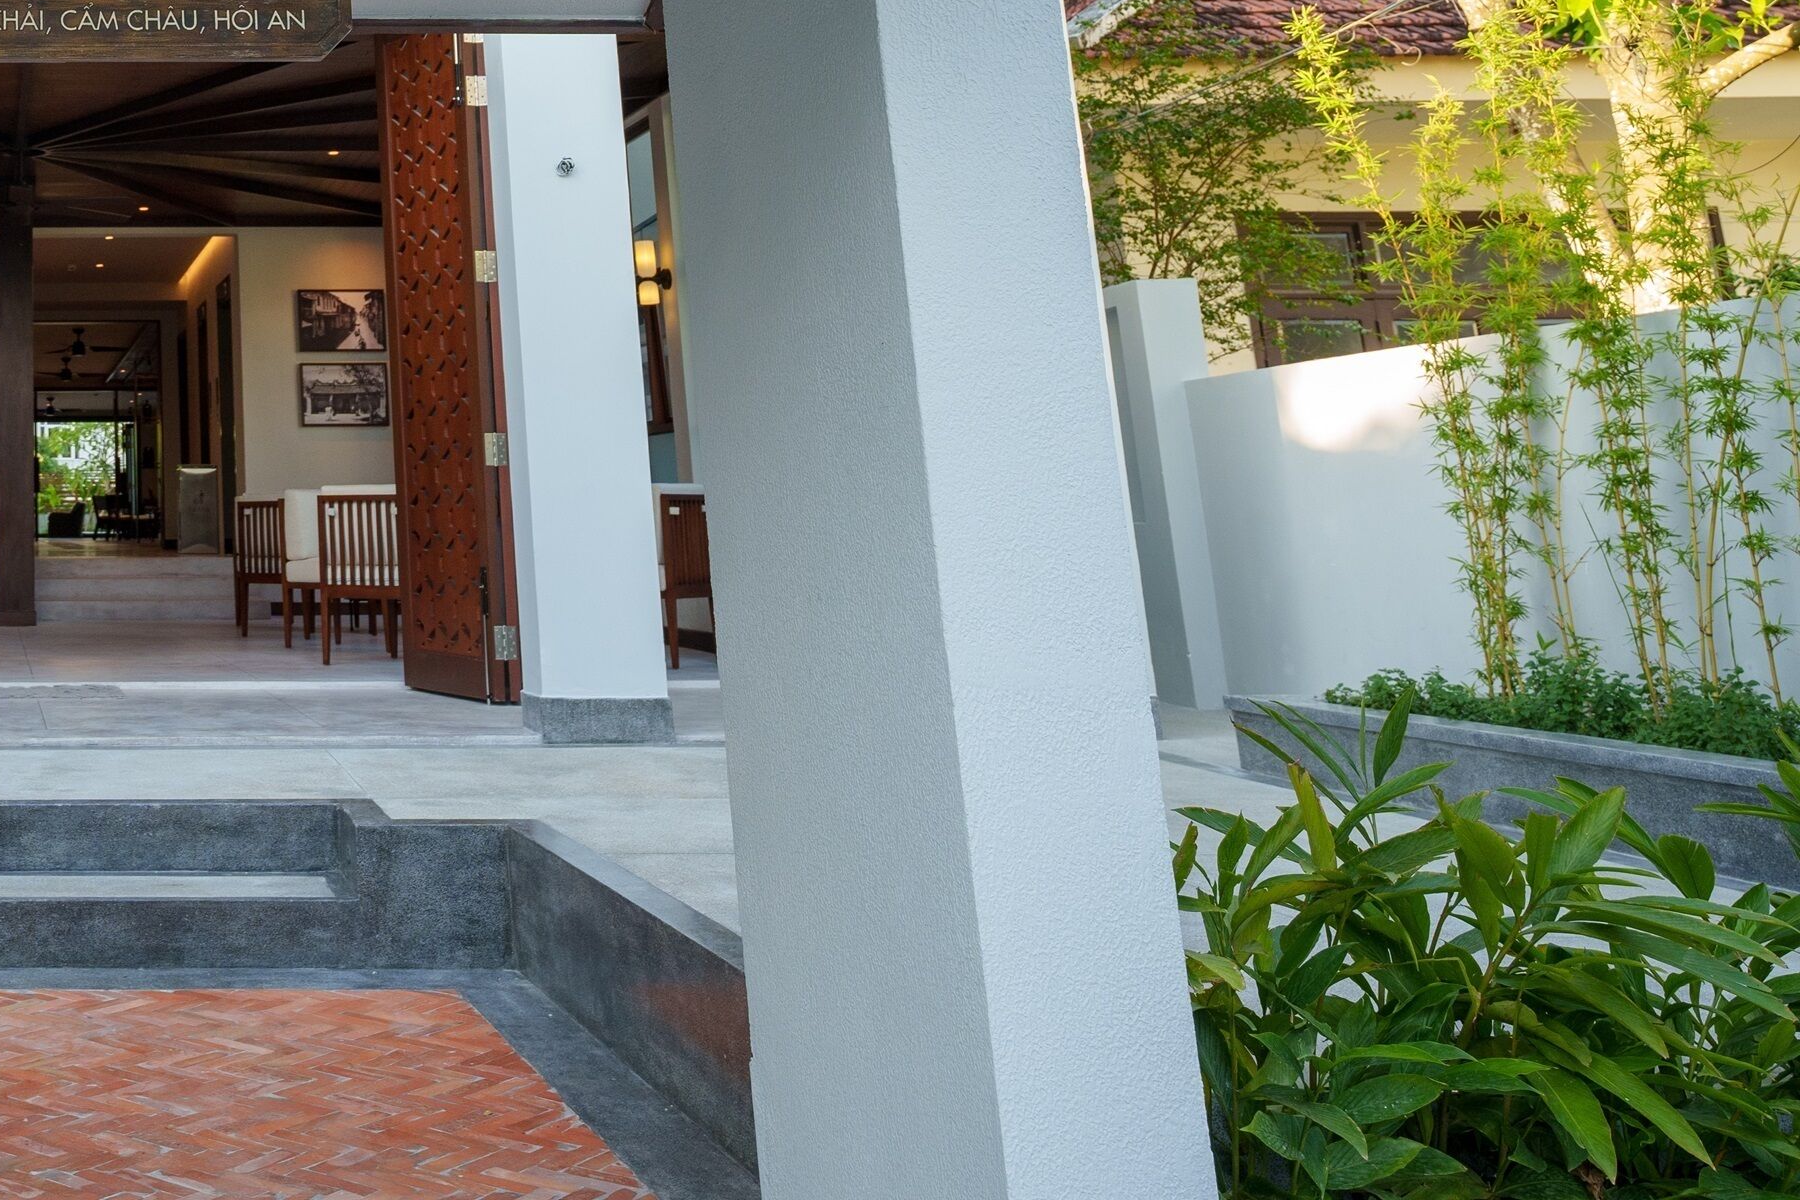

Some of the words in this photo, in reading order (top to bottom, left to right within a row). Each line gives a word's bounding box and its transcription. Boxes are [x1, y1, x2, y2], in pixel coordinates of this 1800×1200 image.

[60, 2, 119, 31] CẨM
[126, 5, 206, 35] CHÂU,
[214, 4, 259, 35] HỘI
[266, 9, 306, 31] AN
